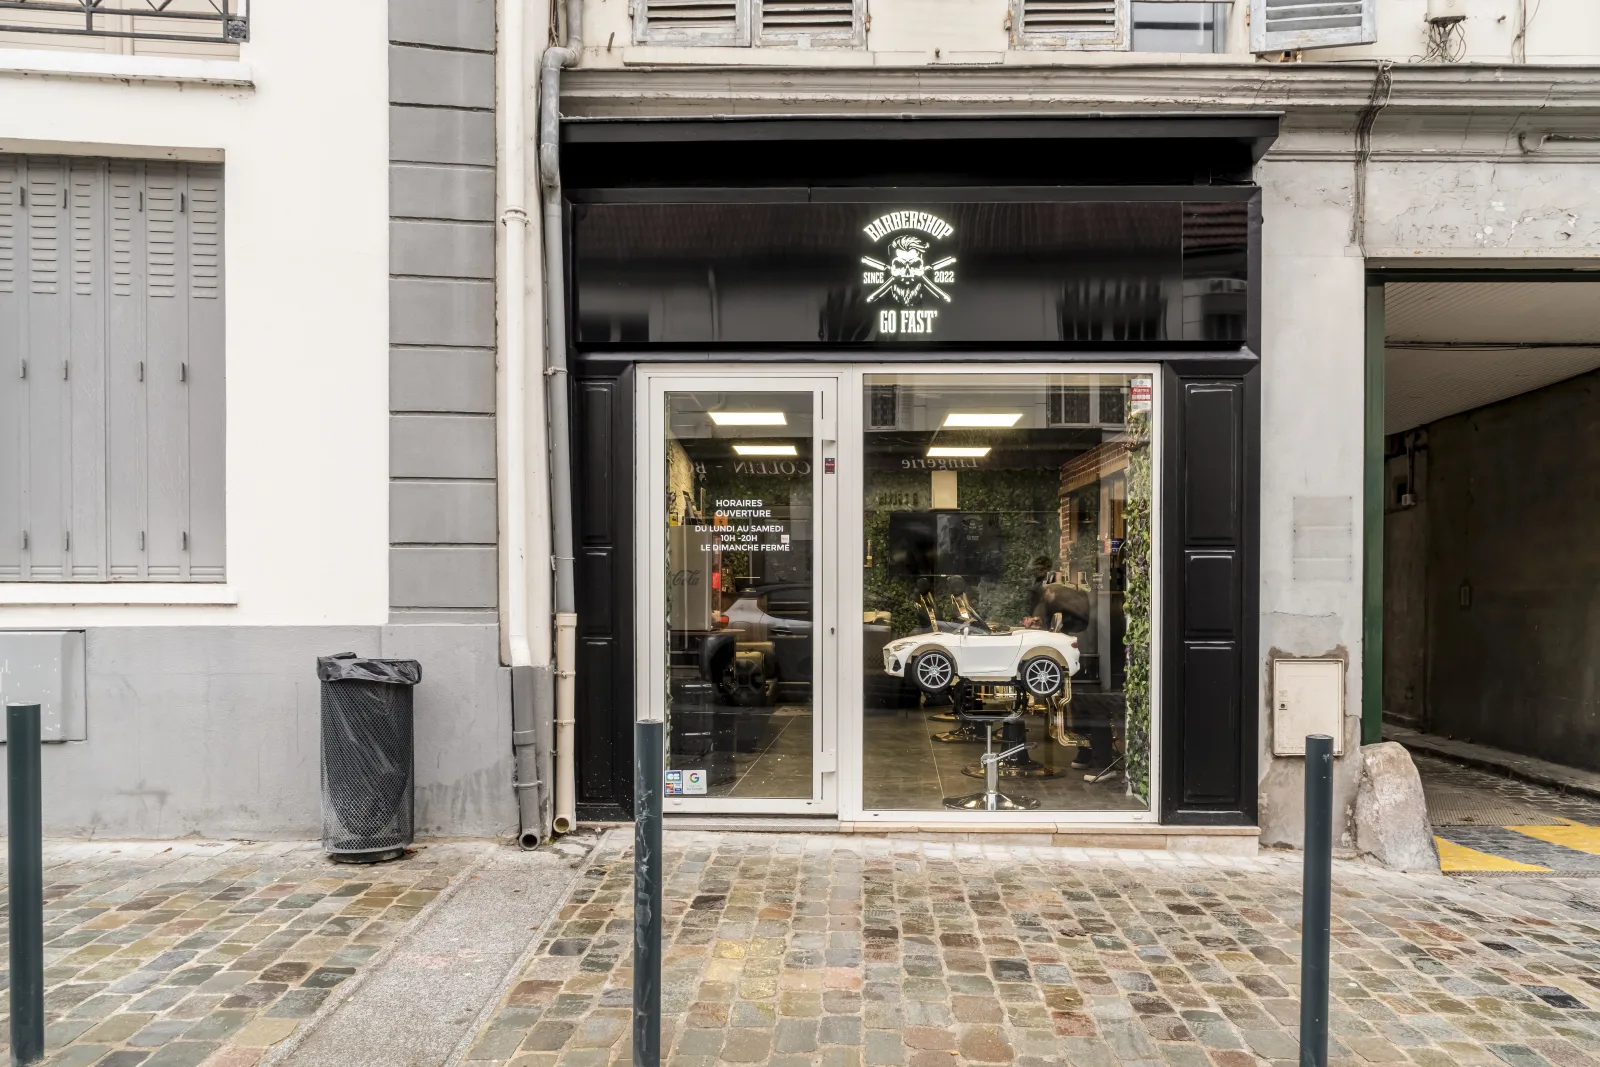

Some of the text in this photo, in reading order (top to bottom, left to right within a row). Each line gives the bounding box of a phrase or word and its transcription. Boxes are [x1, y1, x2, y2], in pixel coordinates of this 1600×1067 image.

[863, 211, 954, 242] BARBERSHOP
[863, 271, 885, 284] SINCE
[934, 271, 955, 283] 2022
[880, 310, 897, 333] GO
[715, 499, 763, 507] HORAIRES
[720, 534, 736, 542] 10H
